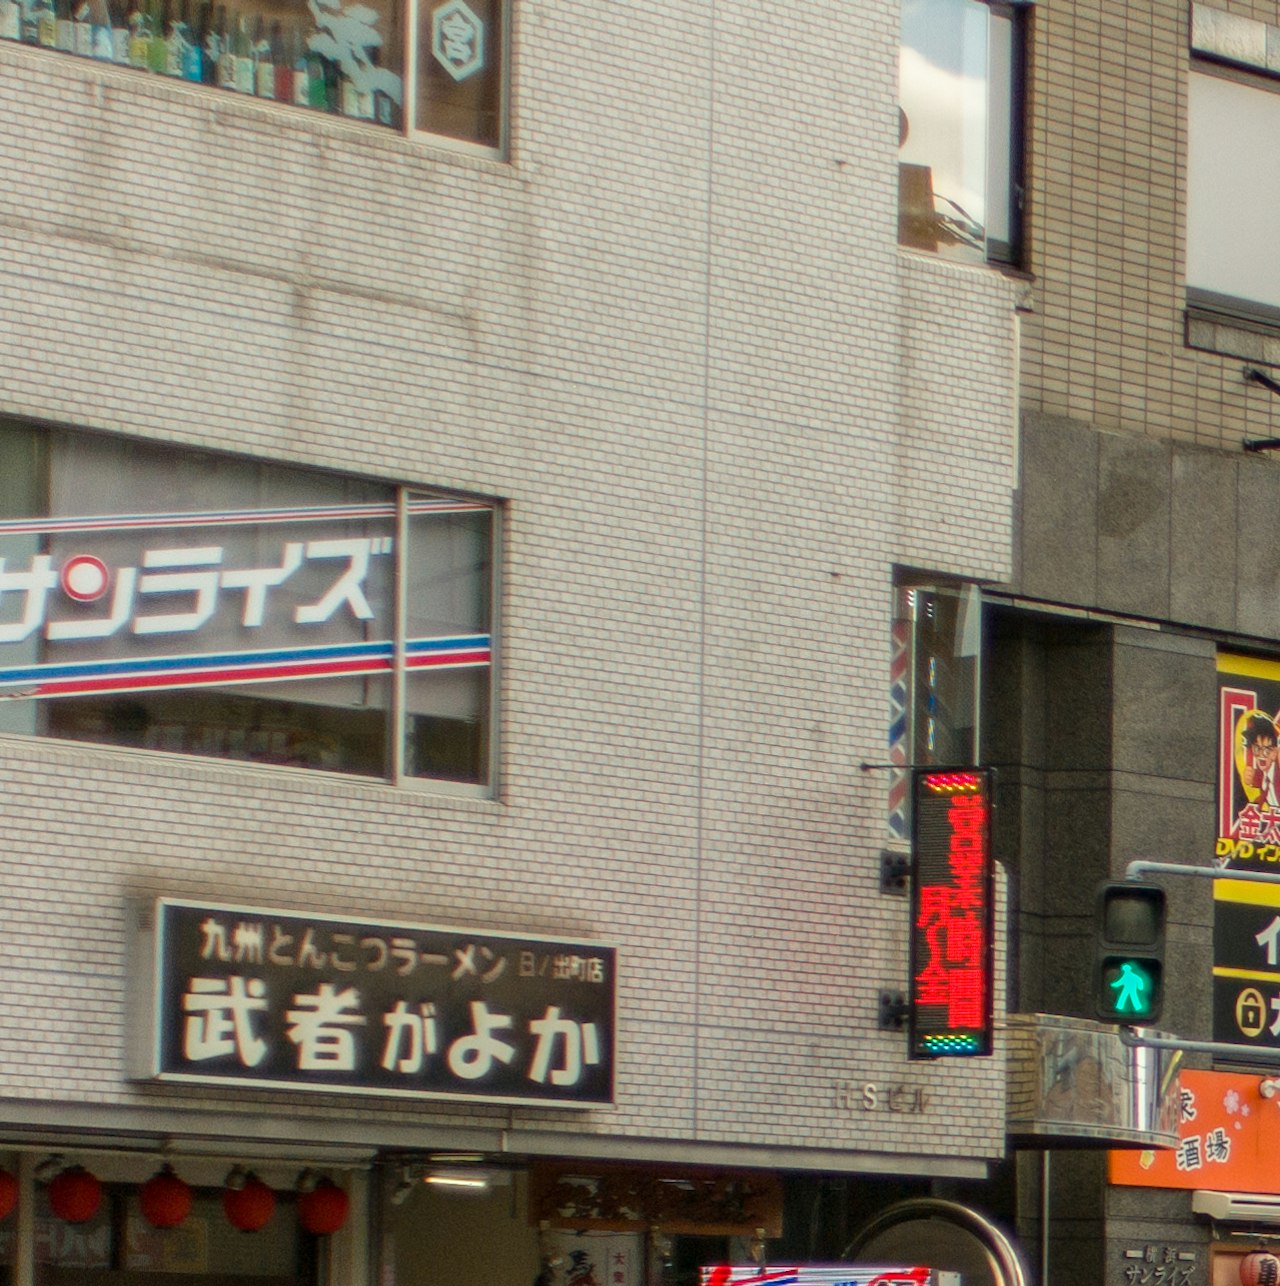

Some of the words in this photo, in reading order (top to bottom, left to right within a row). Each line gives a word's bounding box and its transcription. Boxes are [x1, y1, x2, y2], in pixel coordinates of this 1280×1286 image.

[0, 536, 393, 643] サンライズ
[1215, 837, 1254, 859] DVD
[200, 918, 506, 984] 九州とんこつラーメン
[182, 974, 600, 1087] 武者がよか
[1176, 1128, 1230, 1171] 酒場
